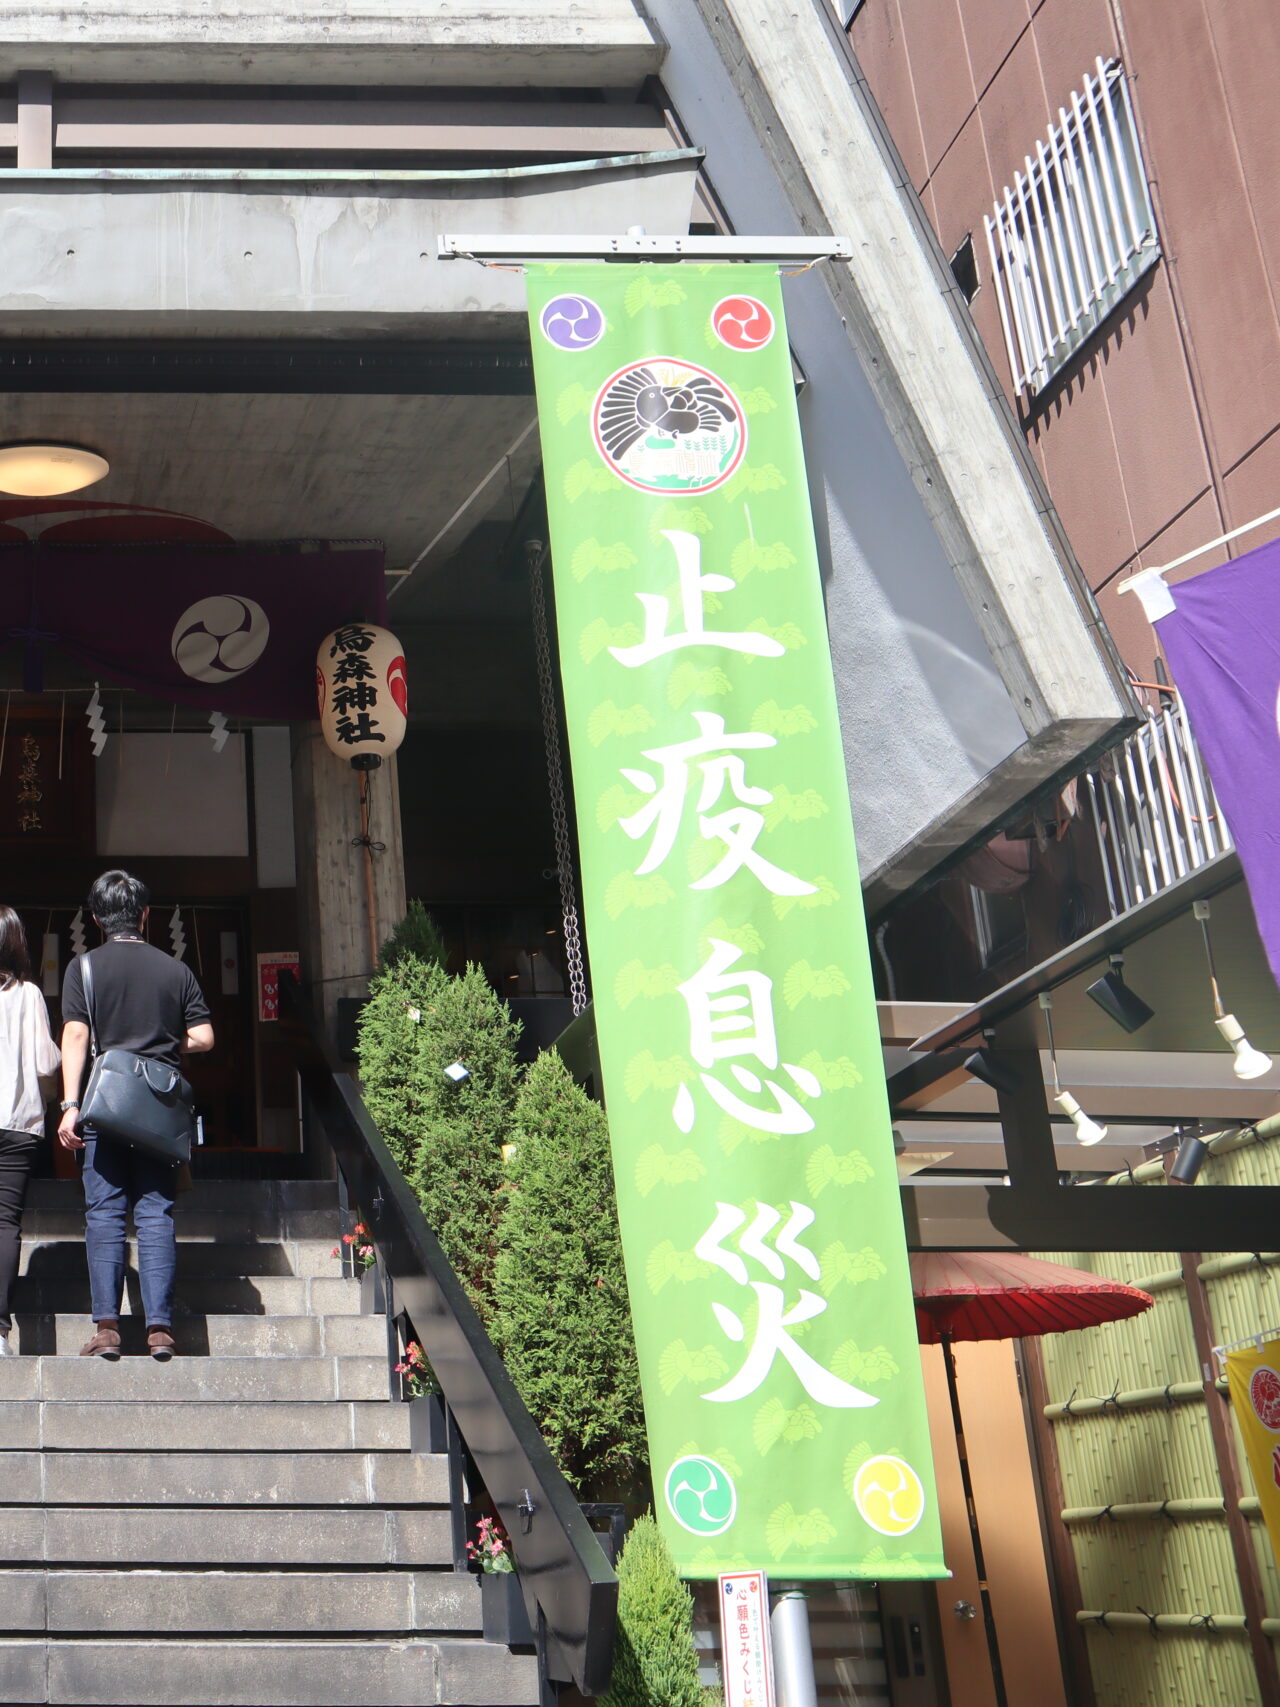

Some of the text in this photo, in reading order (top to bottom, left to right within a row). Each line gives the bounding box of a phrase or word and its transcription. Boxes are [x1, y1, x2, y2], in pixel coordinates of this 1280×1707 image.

[330, 625, 385, 745] 烏森神社
[606, 530, 881, 1409] 止疫息災
